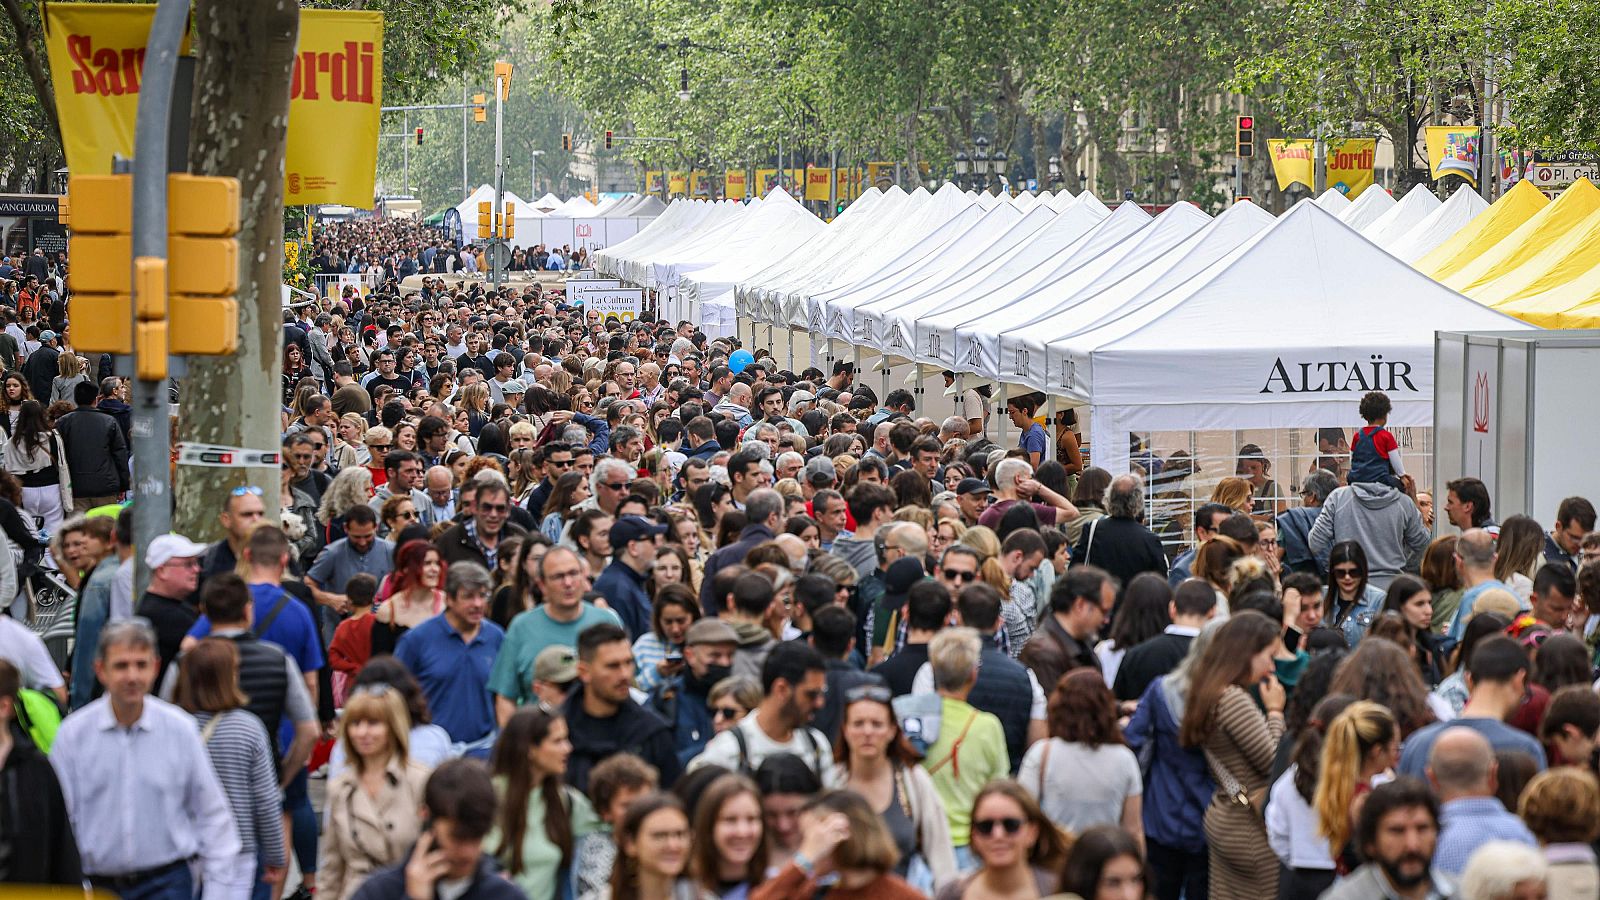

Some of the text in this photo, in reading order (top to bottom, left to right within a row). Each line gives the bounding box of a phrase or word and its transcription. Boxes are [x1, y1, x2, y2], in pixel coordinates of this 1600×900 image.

[67, 34, 374, 104] San rdi
[1329, 149, 1372, 170] Jordi
[809, 173, 828, 184] Sant
[1554, 169, 1569, 180] Pl.
[591, 296, 602, 304] La
[603, 296, 635, 304] Cultura
[1259, 354, 1419, 394] ALTAÏR
